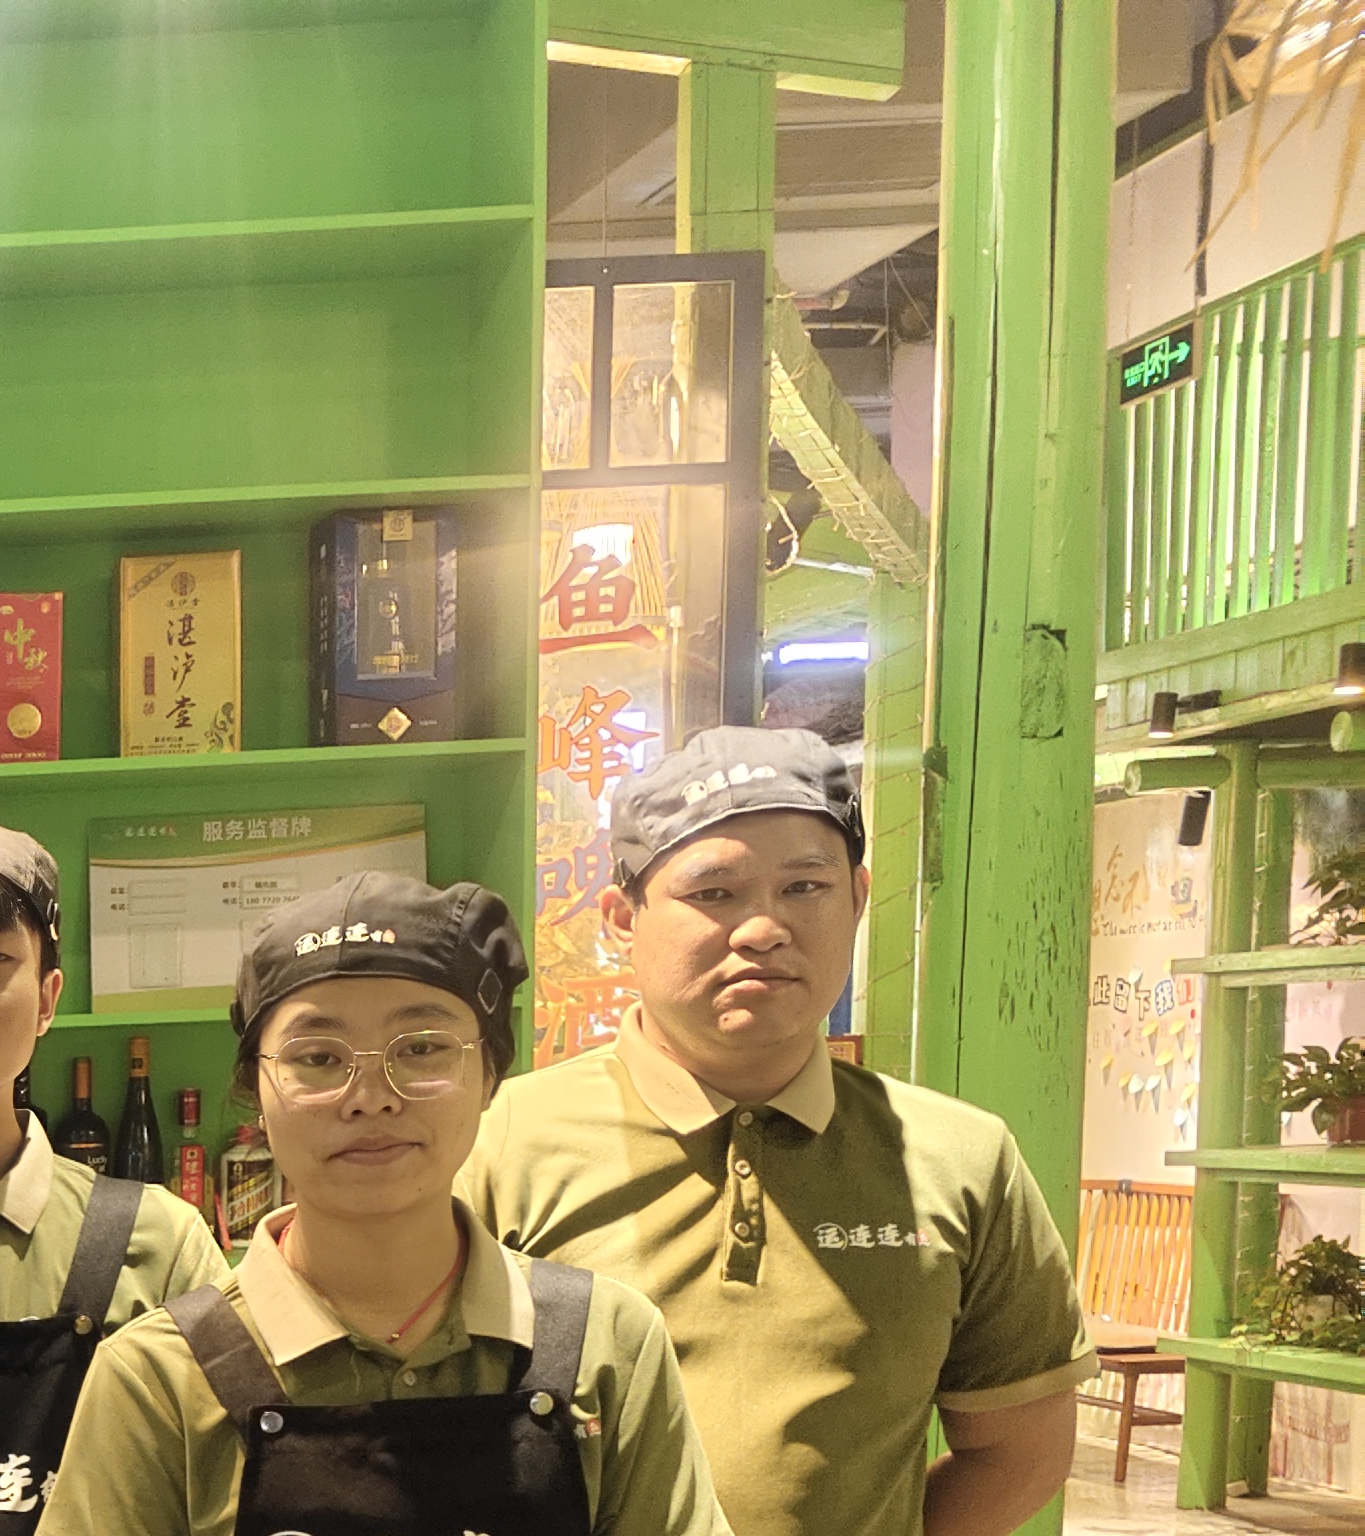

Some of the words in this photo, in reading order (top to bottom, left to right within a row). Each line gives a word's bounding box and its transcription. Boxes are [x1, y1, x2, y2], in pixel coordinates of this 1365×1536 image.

[202, 816, 313, 842] 服务监督牌
